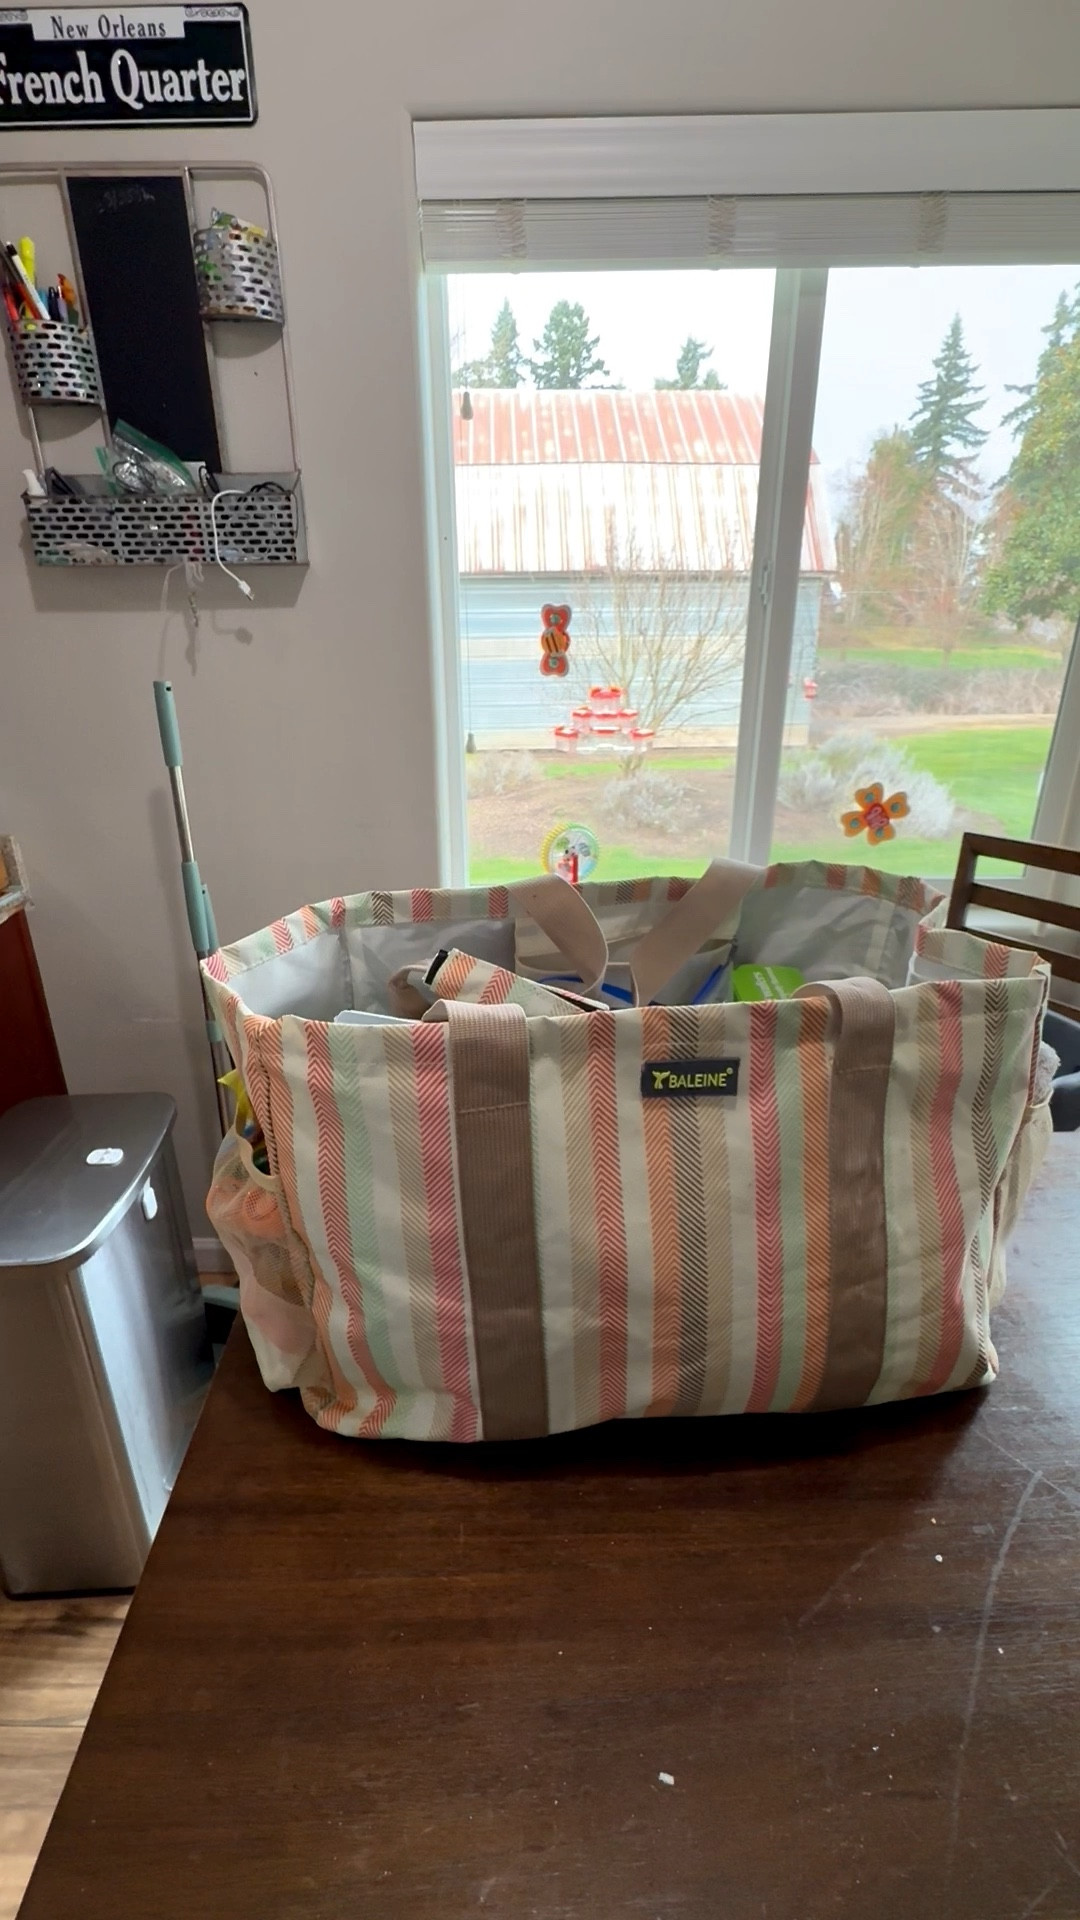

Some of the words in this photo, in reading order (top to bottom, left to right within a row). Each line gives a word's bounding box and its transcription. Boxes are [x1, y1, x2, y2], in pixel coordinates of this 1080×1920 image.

[51, 16, 88, 39] New
[98, 14, 167, 39] Orleans
[110, 49, 246, 110] Quarter
